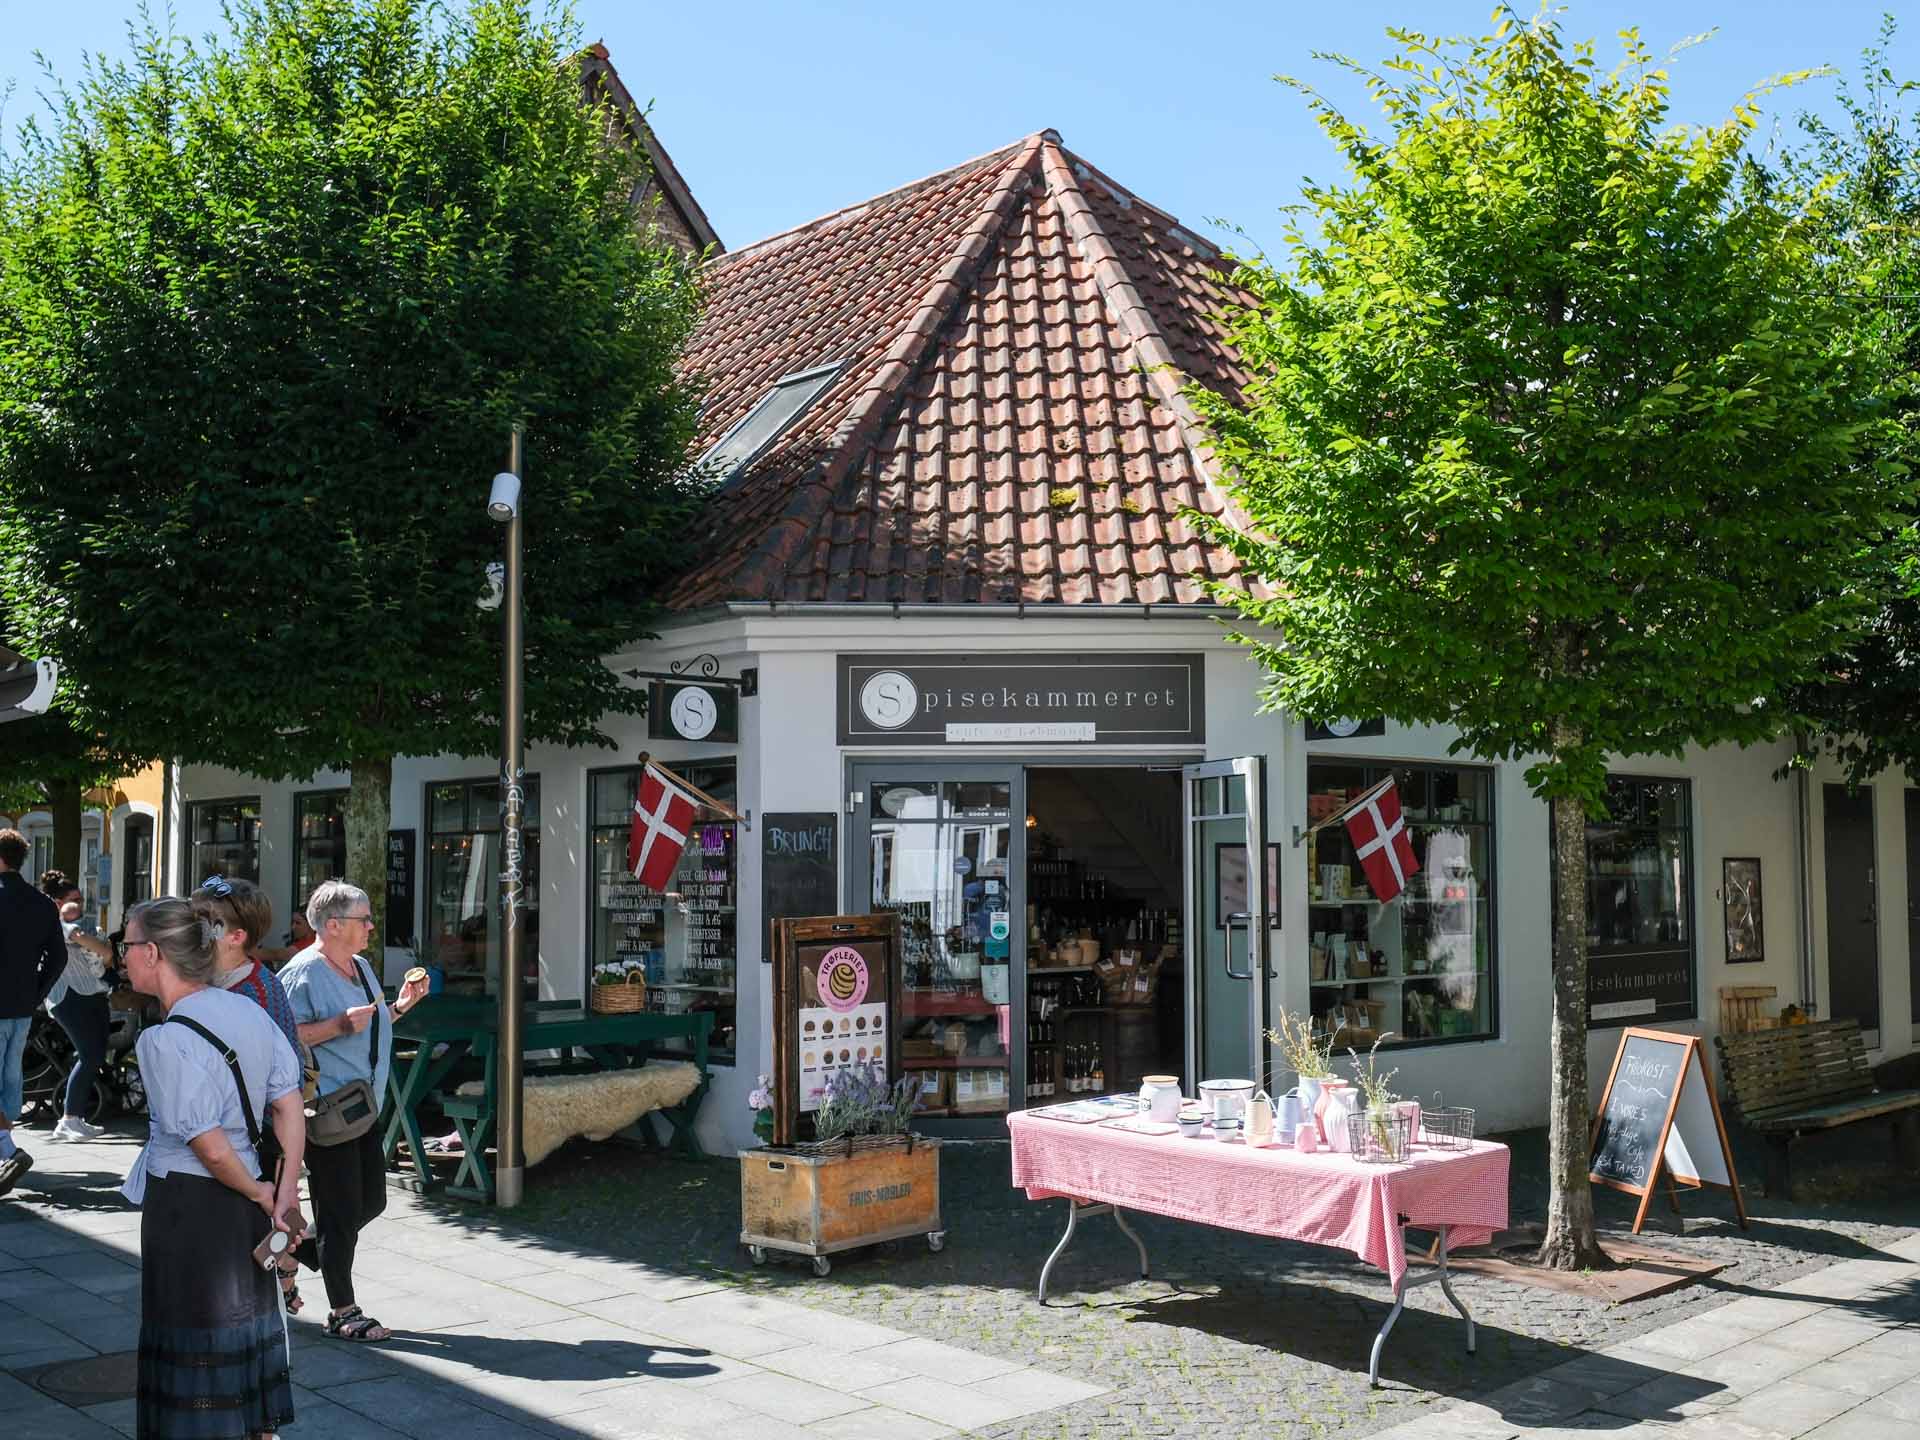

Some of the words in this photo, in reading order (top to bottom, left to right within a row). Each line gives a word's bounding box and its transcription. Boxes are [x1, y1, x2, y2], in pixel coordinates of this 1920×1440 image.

[683, 695, 704, 730] S
[766, 826, 832, 861] BRUNCH
[821, 951, 865, 976] TRØFLERIET
